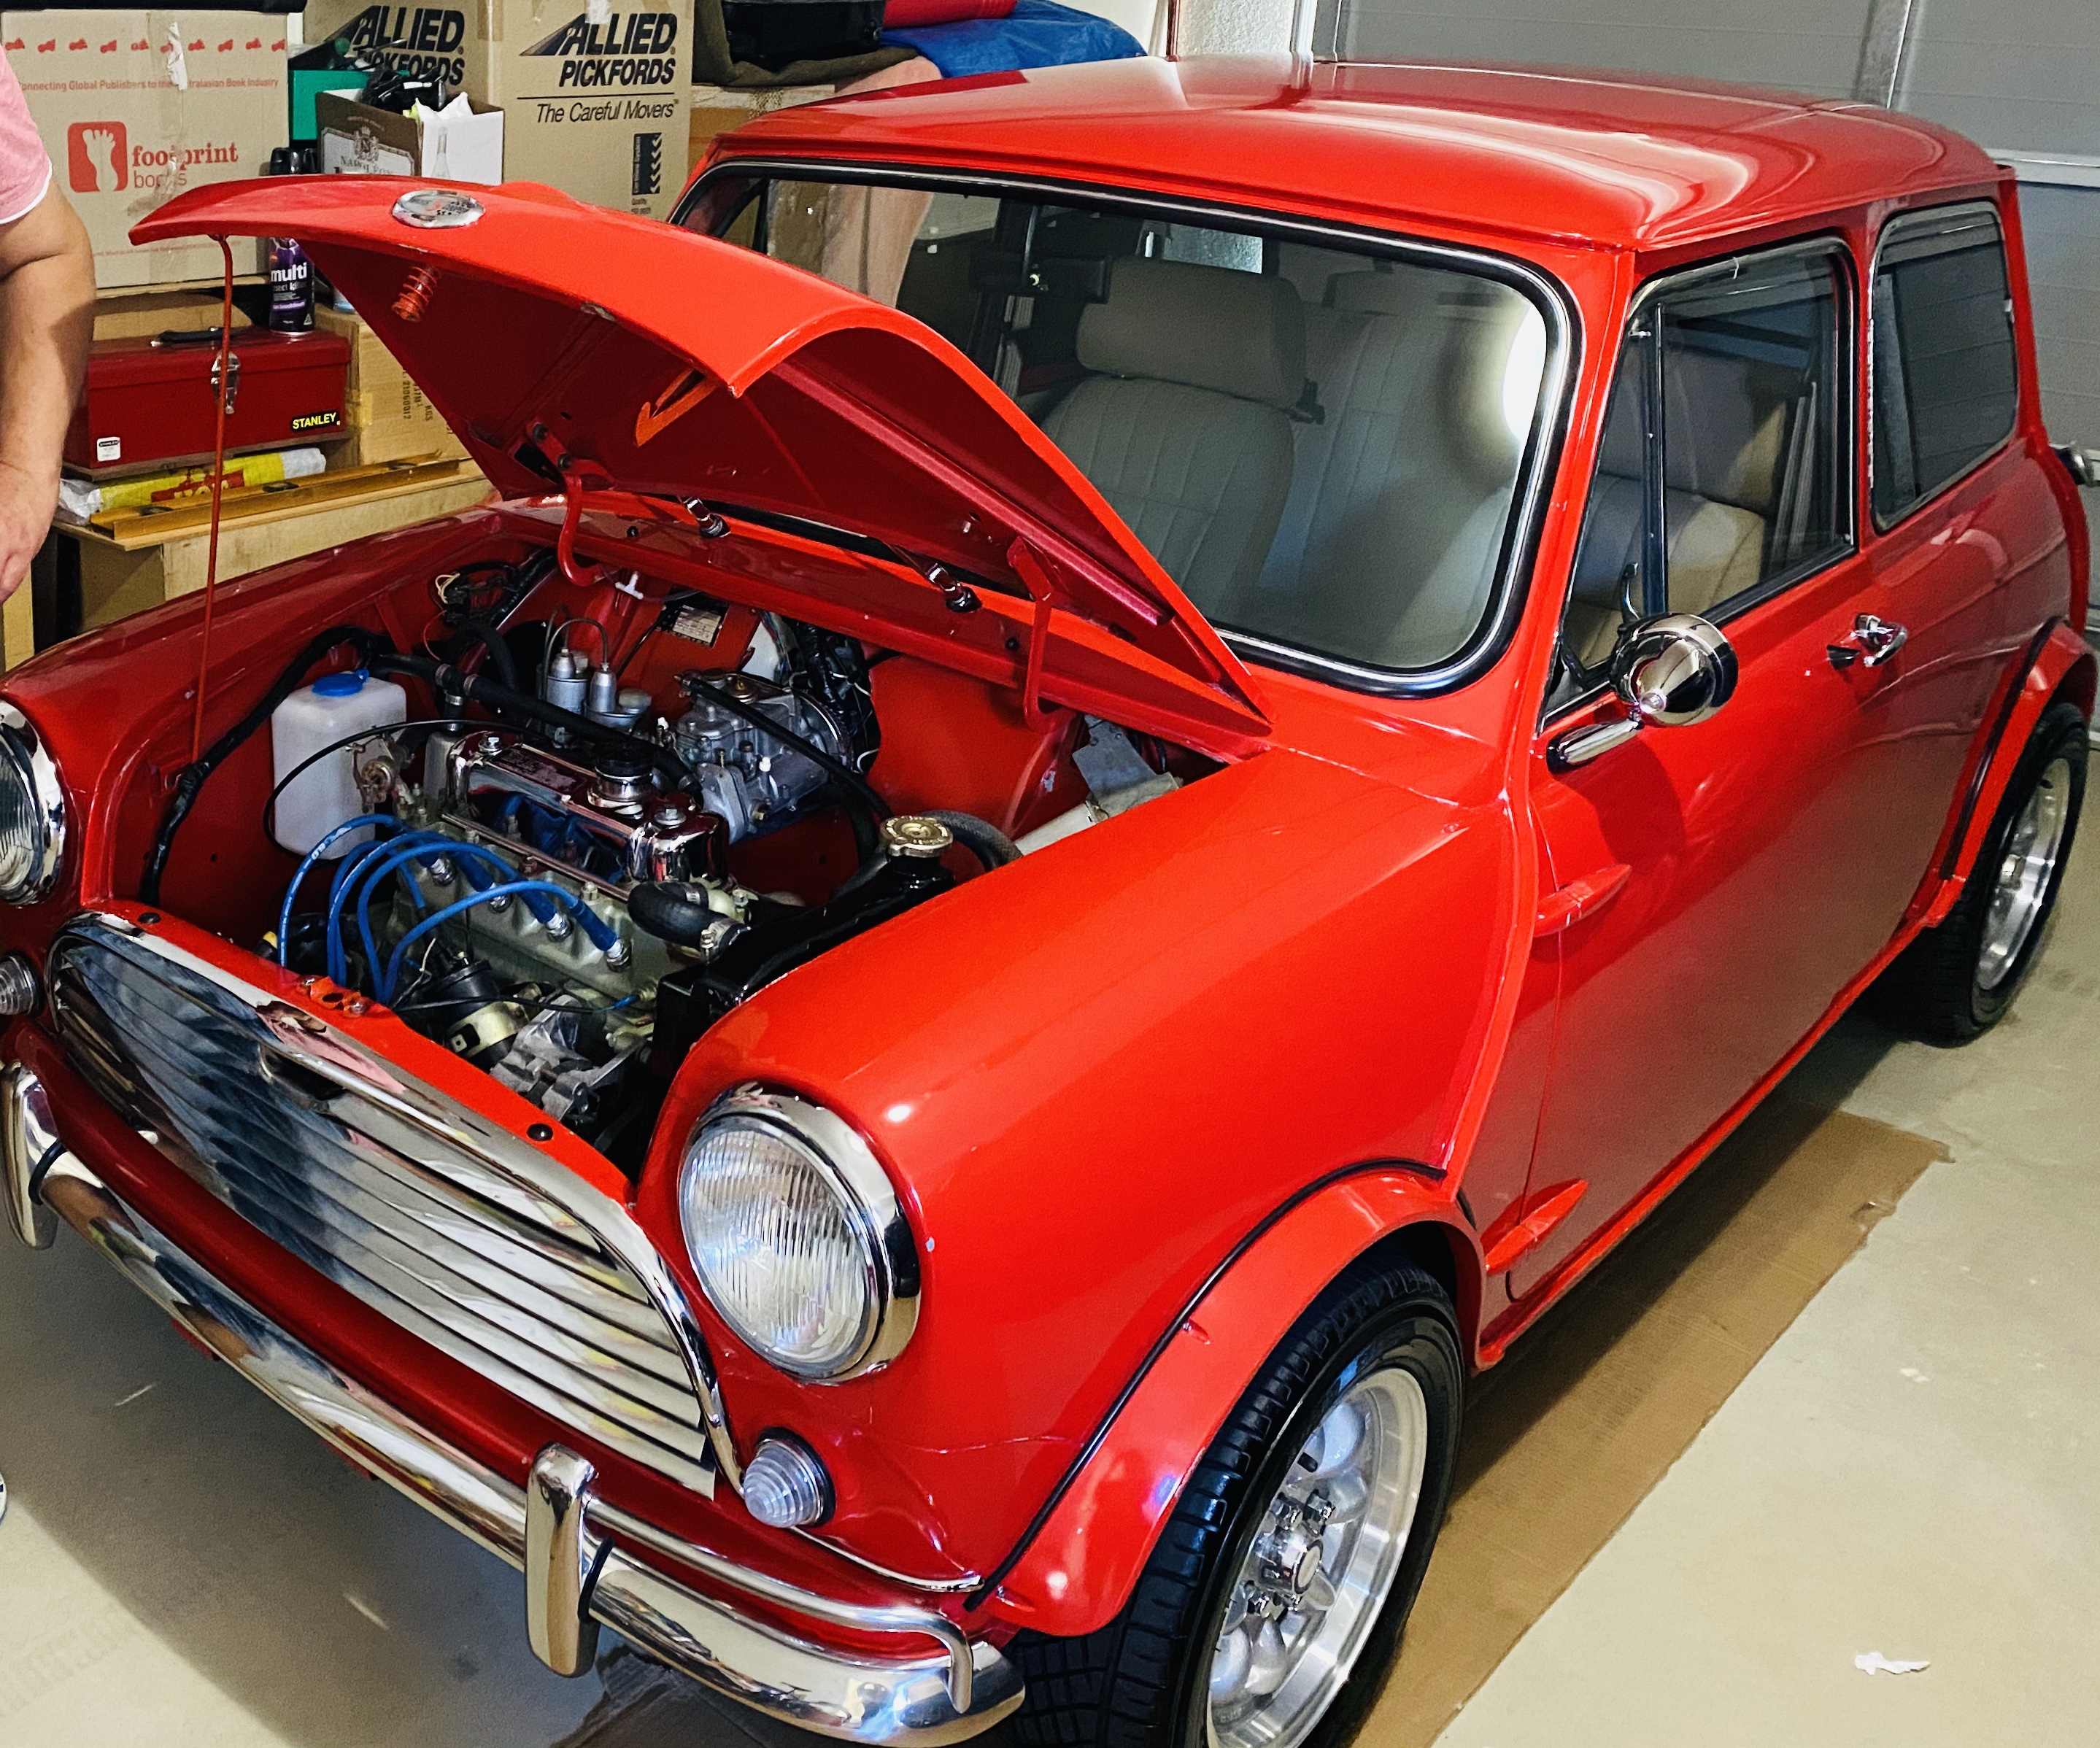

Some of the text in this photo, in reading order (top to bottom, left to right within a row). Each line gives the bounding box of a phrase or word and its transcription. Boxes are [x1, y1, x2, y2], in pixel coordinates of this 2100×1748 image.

[352, 5, 465, 53] ALLIED
[558, 13, 677, 55] ALLIED
[69, 80, 97, 90] Global
[99, 79, 146, 90] Publishers
[147, 79, 156, 88] to
[226, 77, 245, 88] Book
[247, 78, 279, 89] Industry
[559, 58, 676, 87] PICKFORDS
[536, 104, 565, 123] The
[570, 101, 622, 123] Careful
[271, 262, 307, 282] multi
[293, 412, 336, 430] STANLEY
